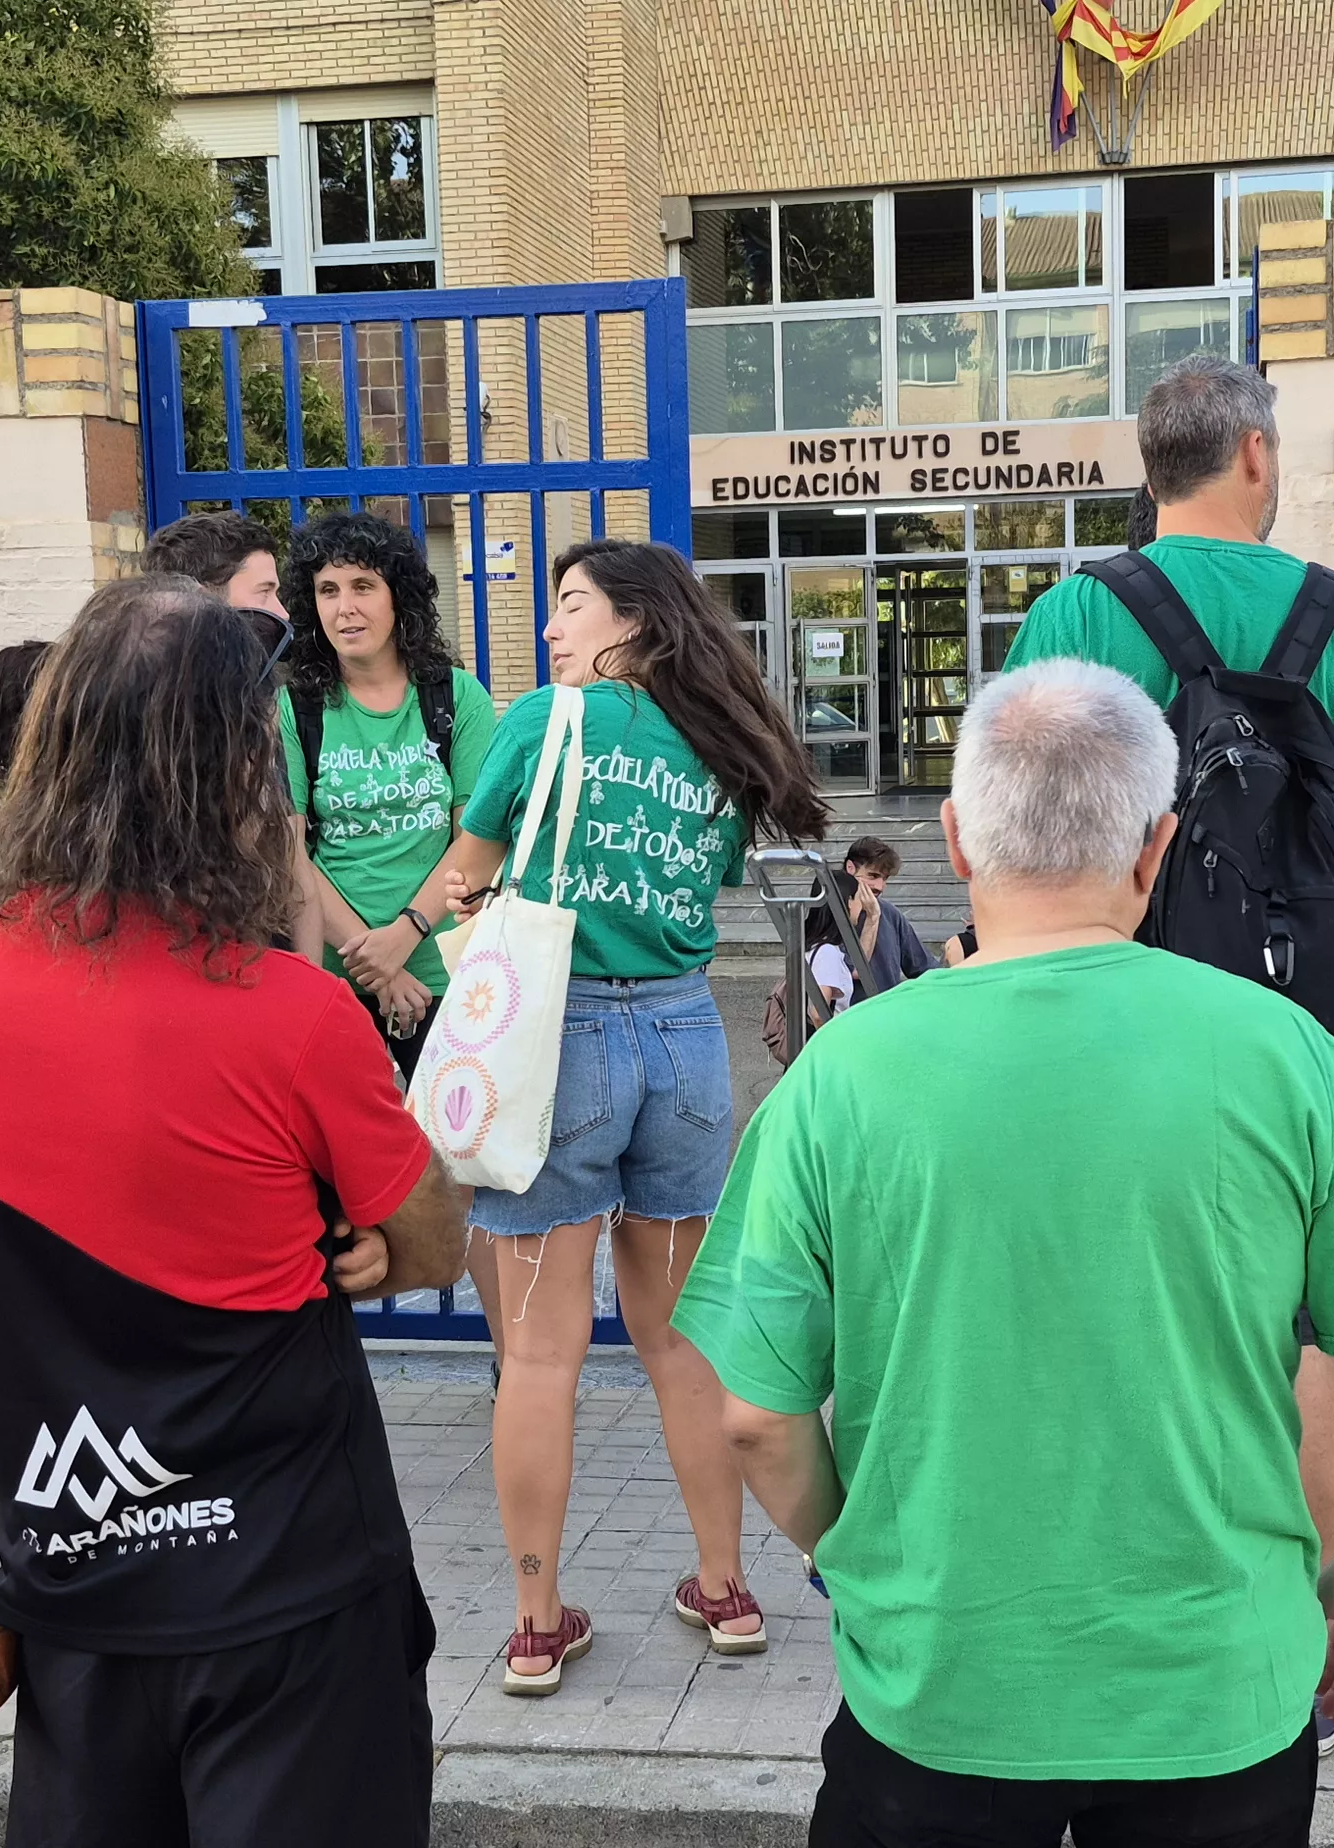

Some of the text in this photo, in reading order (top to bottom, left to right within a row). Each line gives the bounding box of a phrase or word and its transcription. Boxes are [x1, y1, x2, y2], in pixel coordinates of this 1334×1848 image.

[789, 430, 1021, 465] INSTITUTO DE
[712, 460, 1105, 500] EDUCACIÓN SECUNDARIA
[816, 641, 841, 650] SALIDA
[319, 748, 383, 772] SCUELA
[582, 754, 659, 798] SCUELA
[327, 777, 447, 811] DE TOD@S
[323, 818, 383, 841] PARA
[586, 819, 708, 873] DE TOD@S
[556, 872, 632, 905] PARA
[47, 1497, 236, 1555] ARAÑONES
[68, 1528, 239, 1564] DE MONTAÑA
